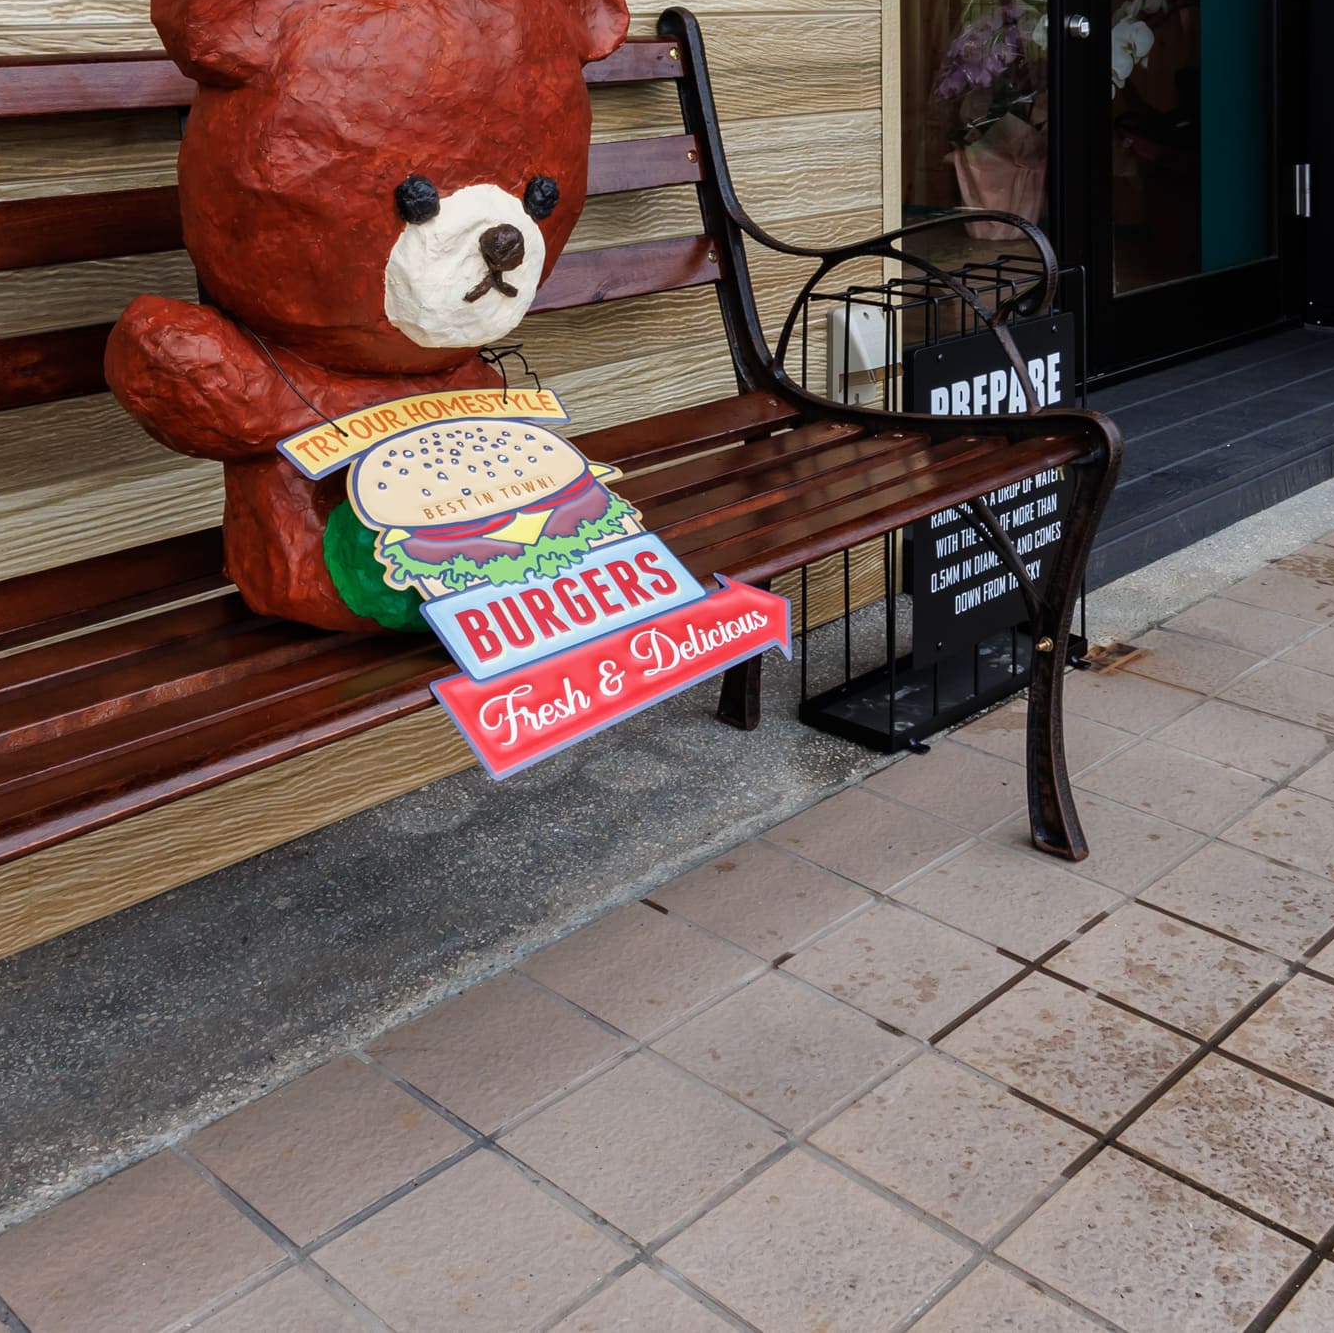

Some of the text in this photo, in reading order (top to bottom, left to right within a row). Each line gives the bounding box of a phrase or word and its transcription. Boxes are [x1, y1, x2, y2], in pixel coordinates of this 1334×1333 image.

[930, 352, 1061, 416] PREPARE
[295, 393, 558, 463] TRY OUR HOMESTYLE
[422, 475, 557, 521] BEST IN TOWN!
[935, 536, 959, 559] WITH
[961, 527, 977, 550] THE
[1012, 502, 1035, 528] MORE
[1036, 492, 1058, 517] THAN
[930, 564, 960, 594] 0.5MM
[962, 558, 972, 580] IN
[1017, 533, 1033, 556] AND
[1034, 521, 1062, 549] COMES
[954, 586, 981, 615] DOWN
[983, 574, 1006, 603] FROM
[1025, 559, 1042, 582] SKY
[454, 550, 679, 666] BURGERS
[478, 609, 769, 747] Fresh & Delicious
